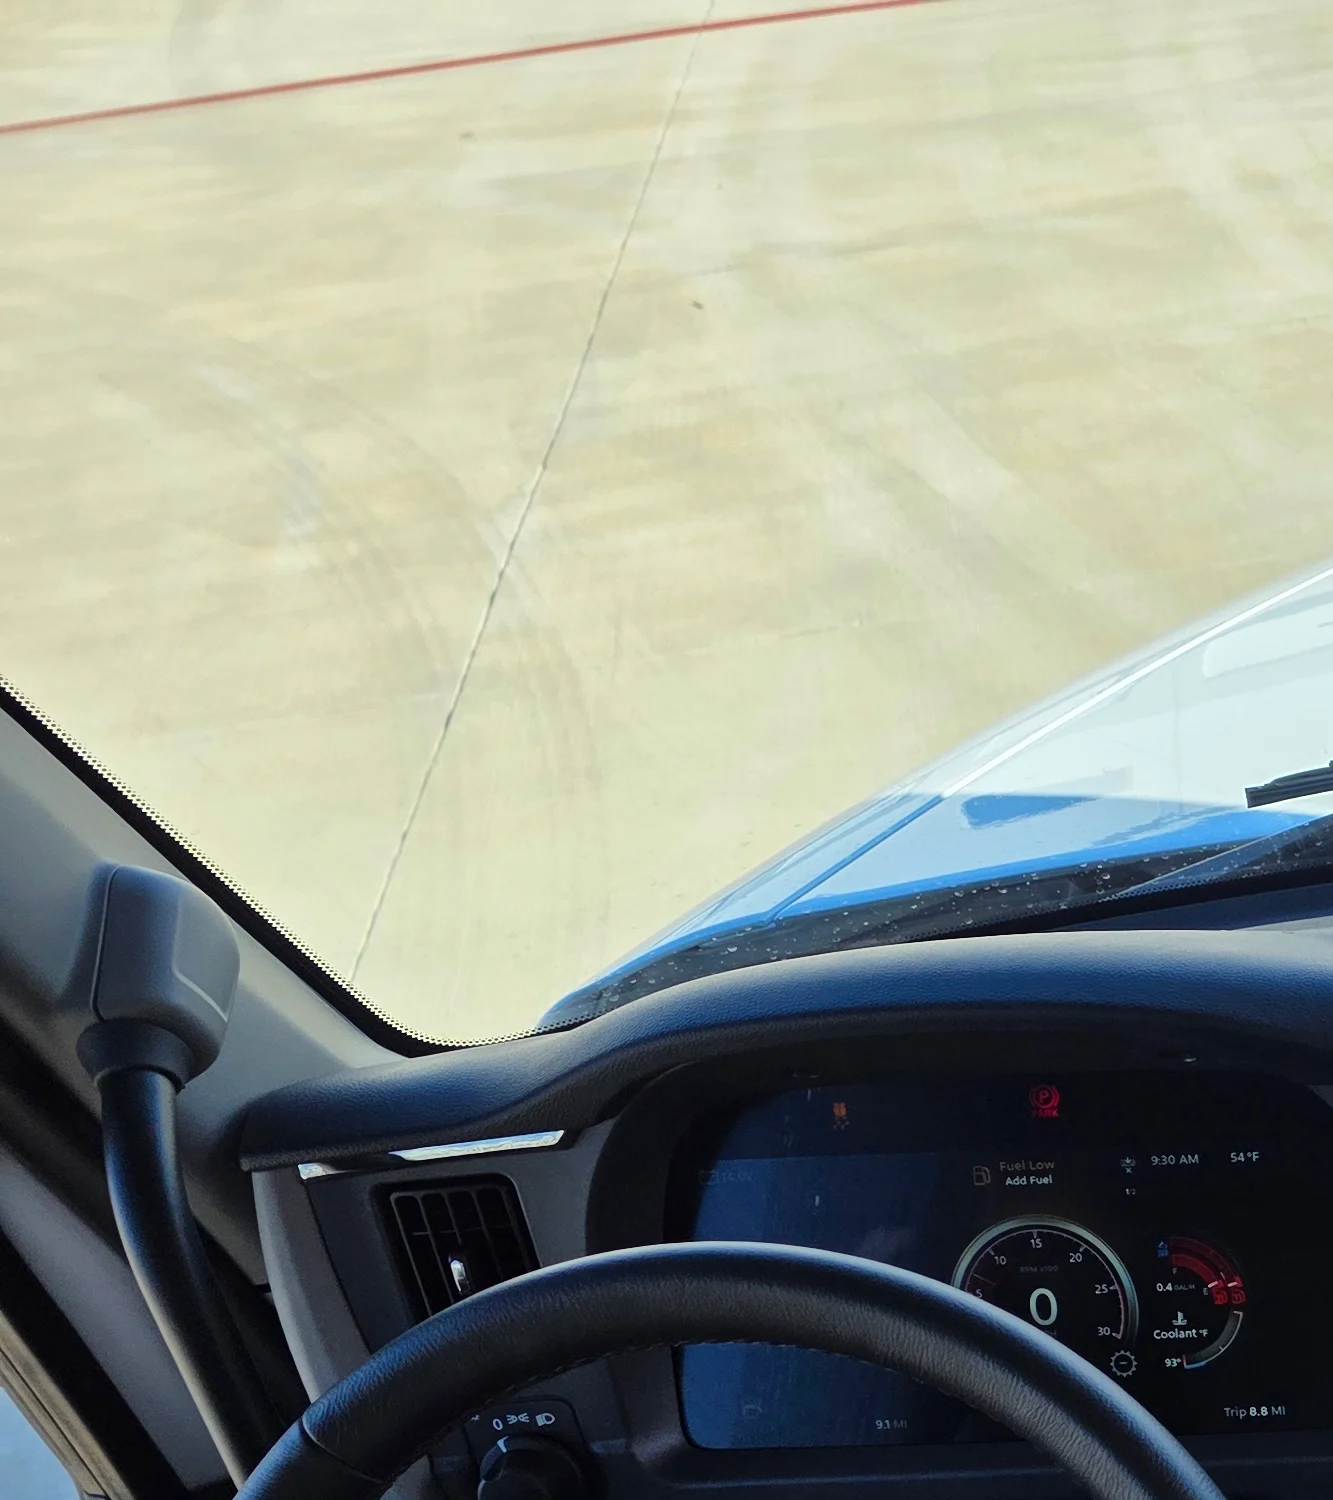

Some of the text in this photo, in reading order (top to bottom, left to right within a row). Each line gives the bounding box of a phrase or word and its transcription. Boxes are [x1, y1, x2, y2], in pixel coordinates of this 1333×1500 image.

[999, 1160, 1055, 1171] Fuel Low
[1150, 1154, 1199, 1166] 9:30 AM
[1005, 1174, 1053, 1186] Add Fuel
[1030, 1238, 1043, 1249] 15
[994, 1255, 1007, 1266] 10
[1069, 1252, 1083, 1263] 20
[1095, 1284, 1108, 1295] 25
[1156, 1282, 1173, 1292] 0.4
[1029, 1287, 1058, 1326] 0
[1097, 1326, 1111, 1336] 30
[1153, 1328, 1198, 1340] Coolant
[1223, 1405, 1286, 1419] Trip 8.8 MI
